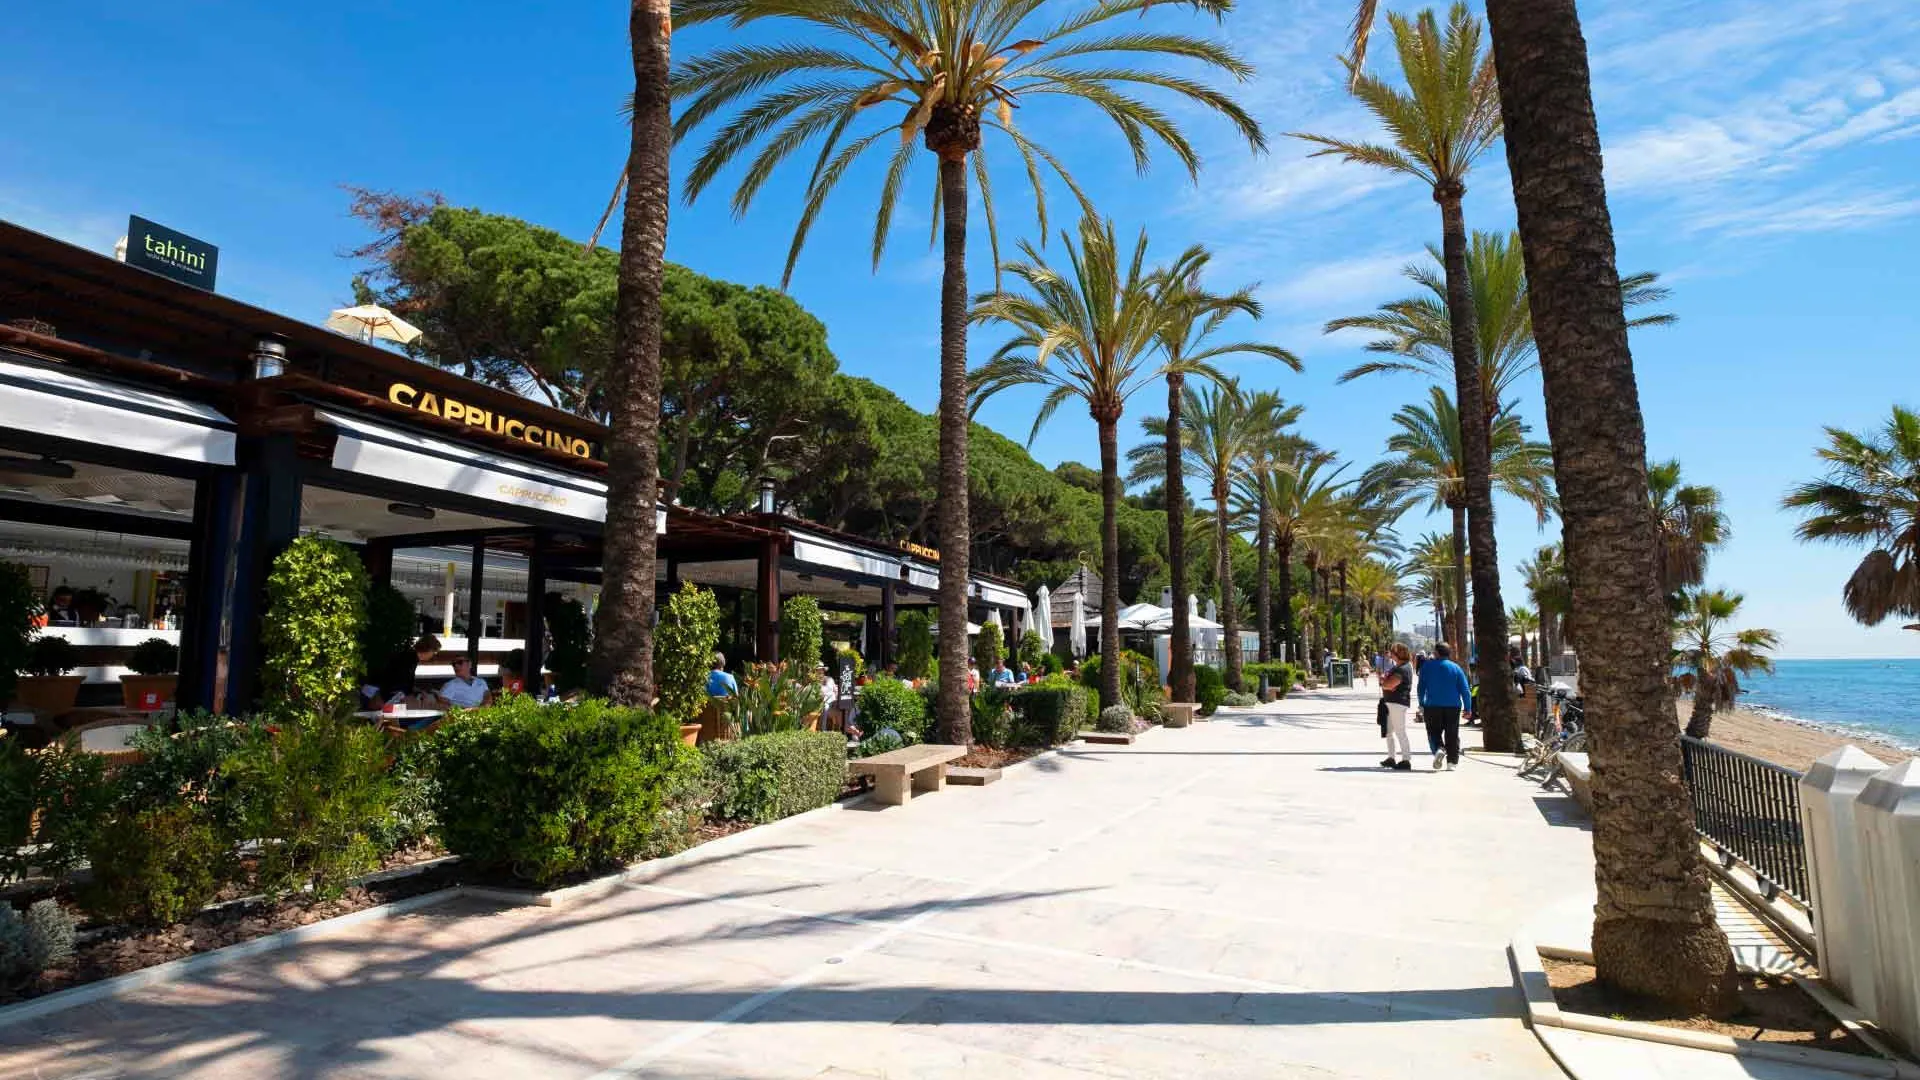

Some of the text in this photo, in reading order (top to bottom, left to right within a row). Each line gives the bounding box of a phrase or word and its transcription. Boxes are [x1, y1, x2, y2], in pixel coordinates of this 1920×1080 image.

[144, 234, 206, 270] tahini
[388, 383, 590, 459] CAPPUCCINO
[498, 484, 567, 506] CAPPUCCINO
[900, 540, 940, 560] CAPPUCCIN
